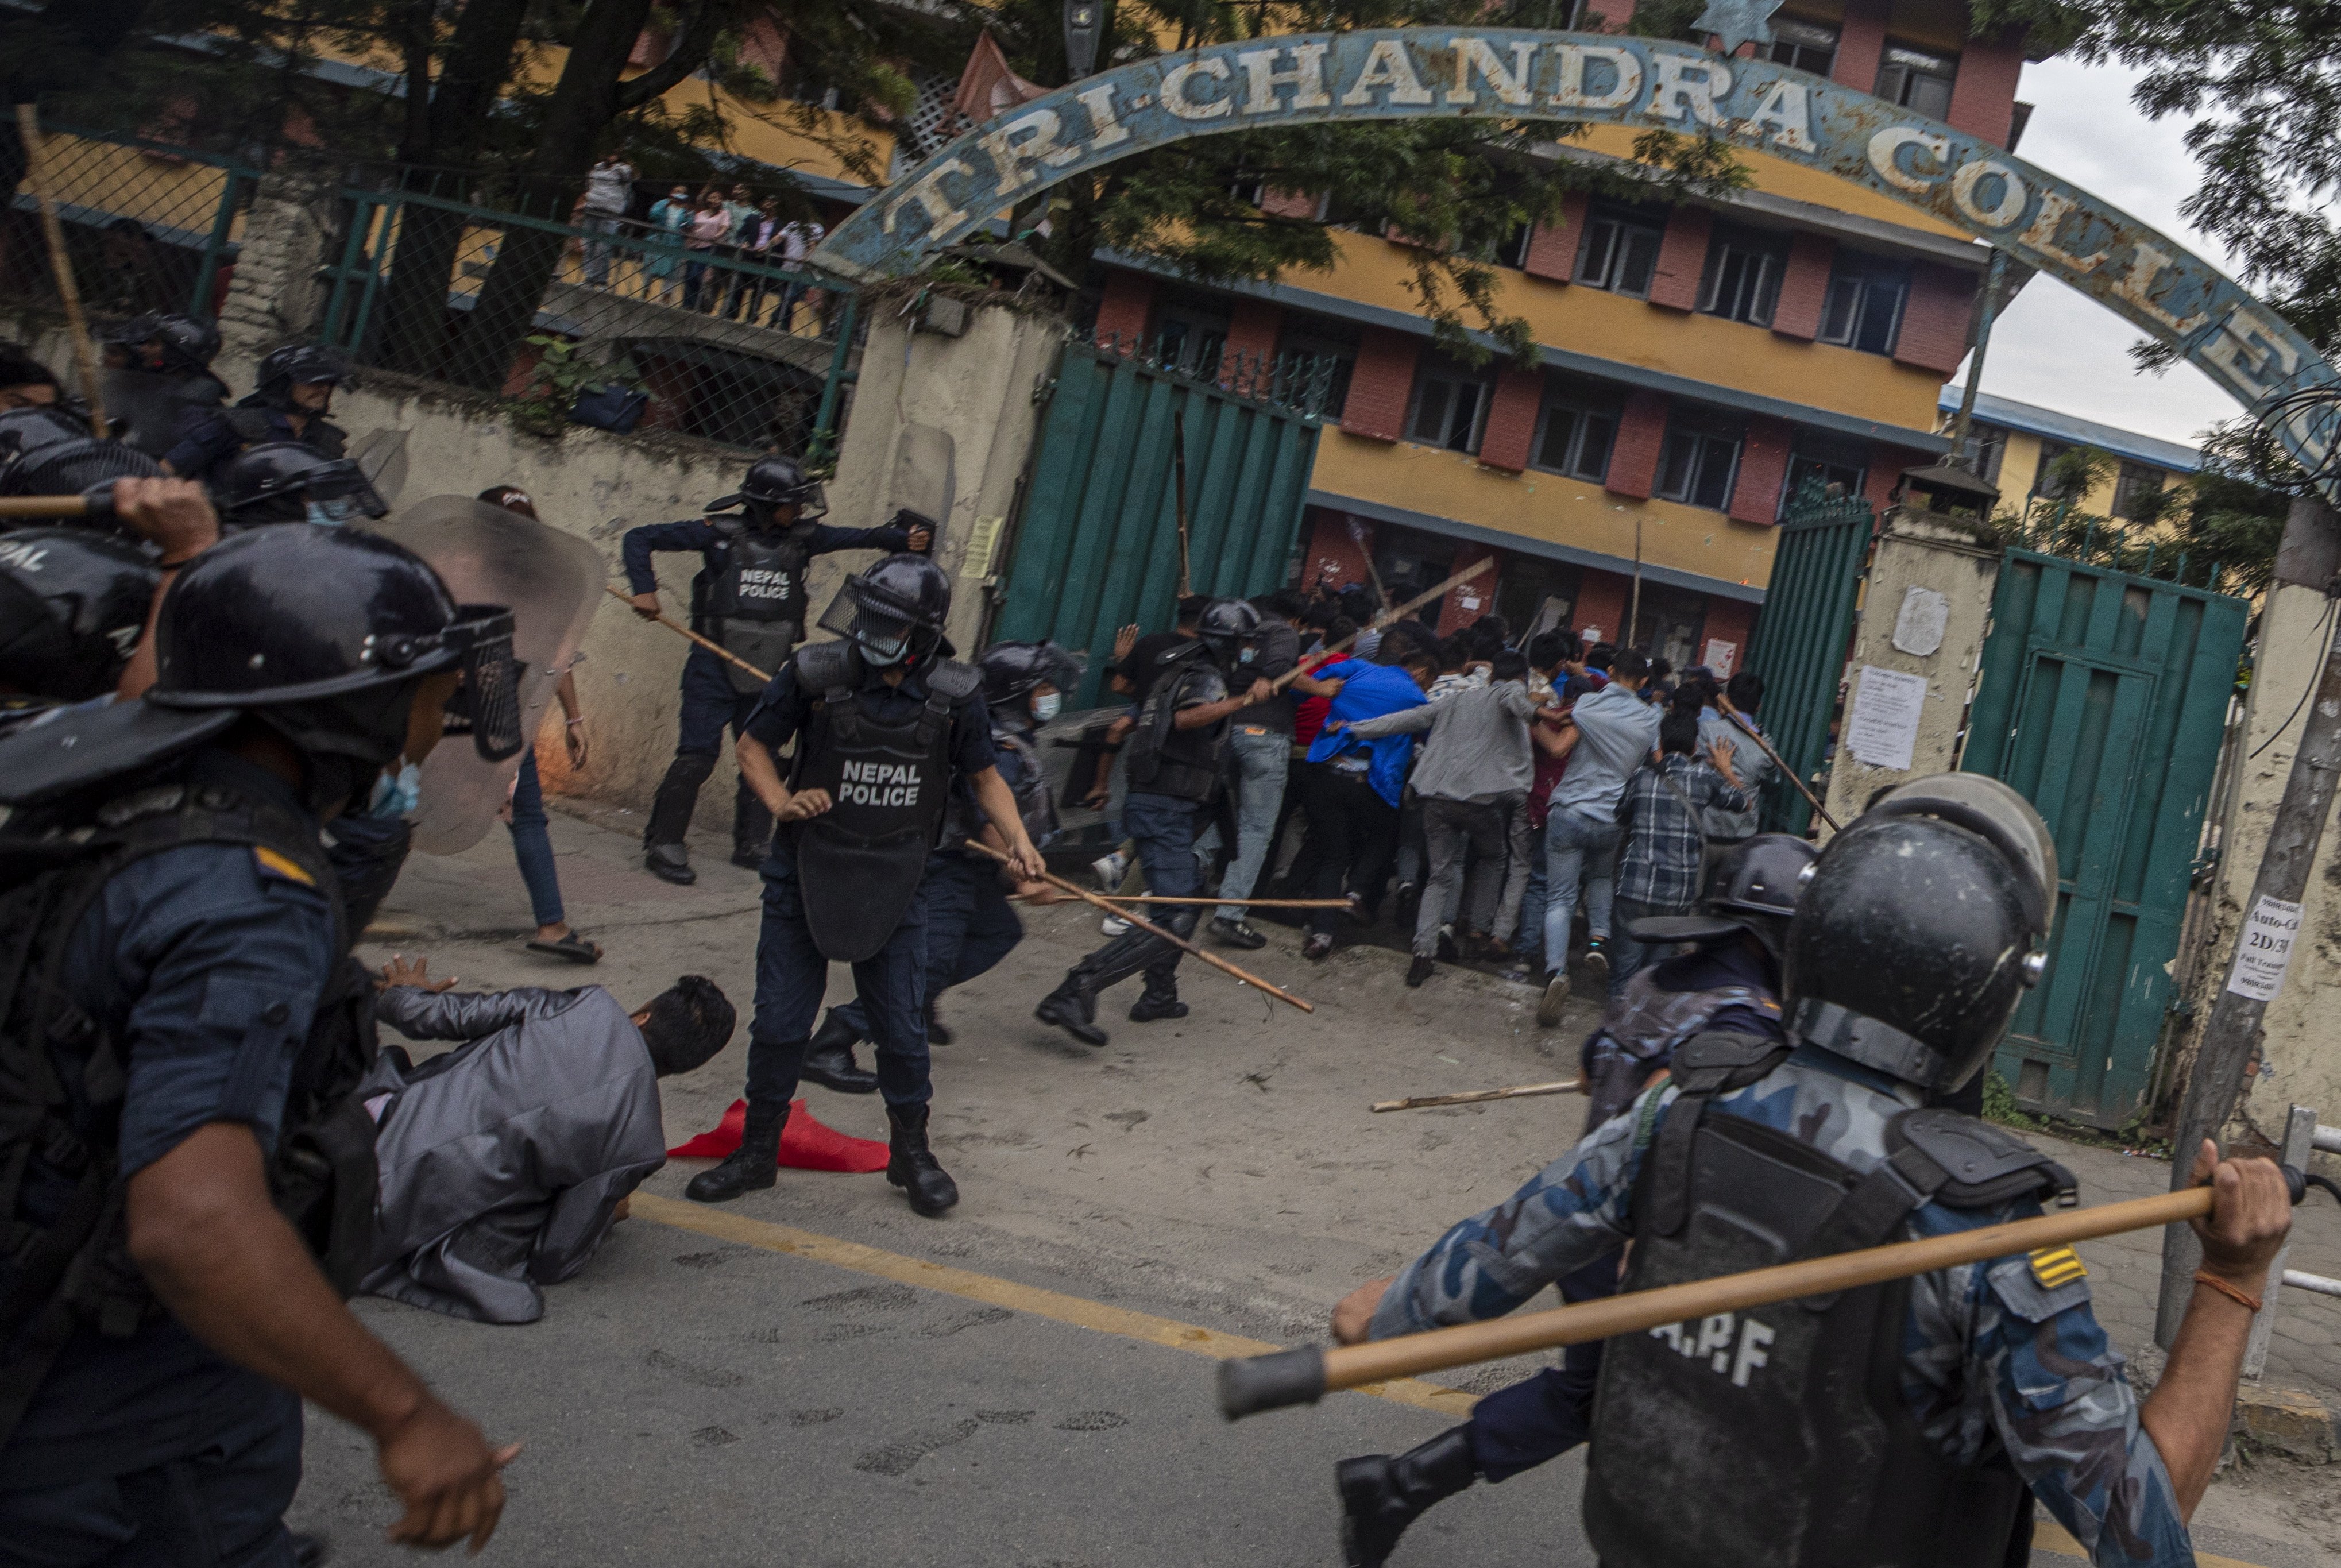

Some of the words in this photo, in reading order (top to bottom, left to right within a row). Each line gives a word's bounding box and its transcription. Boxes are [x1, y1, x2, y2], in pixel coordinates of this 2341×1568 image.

[740, 569, 790, 585] NEPAL
[739, 584, 790, 600] POLICE
[842, 759, 921, 785] NEPAL
[838, 782, 919, 806] POLICE
